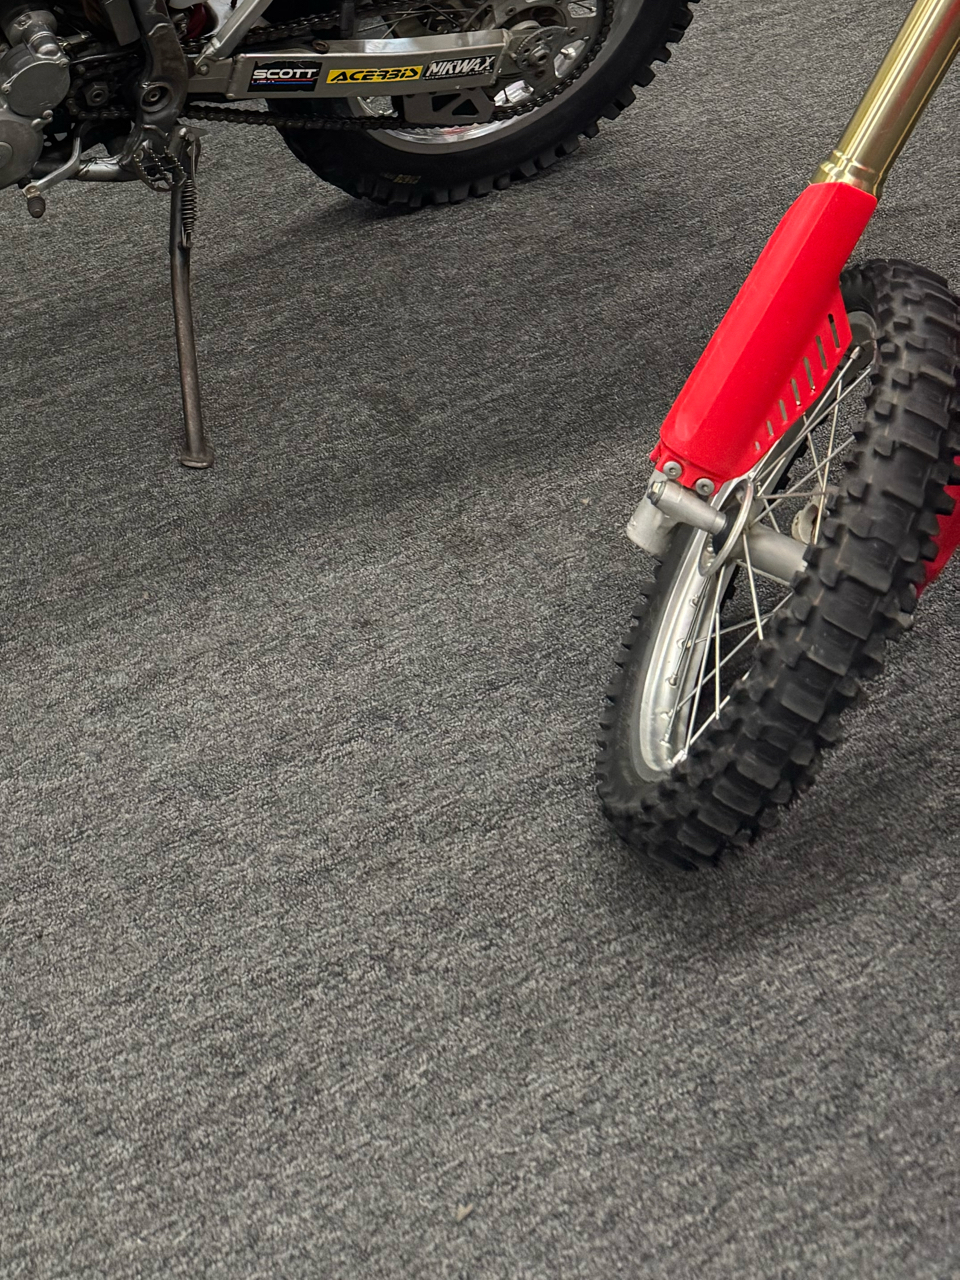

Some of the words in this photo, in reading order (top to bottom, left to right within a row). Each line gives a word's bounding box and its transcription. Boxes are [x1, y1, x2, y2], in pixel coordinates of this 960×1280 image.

[425, 56, 496, 77] NIKWAX
[252, 68, 319, 80] SCOTT
[330, 69, 419, 82] ACERBIS
